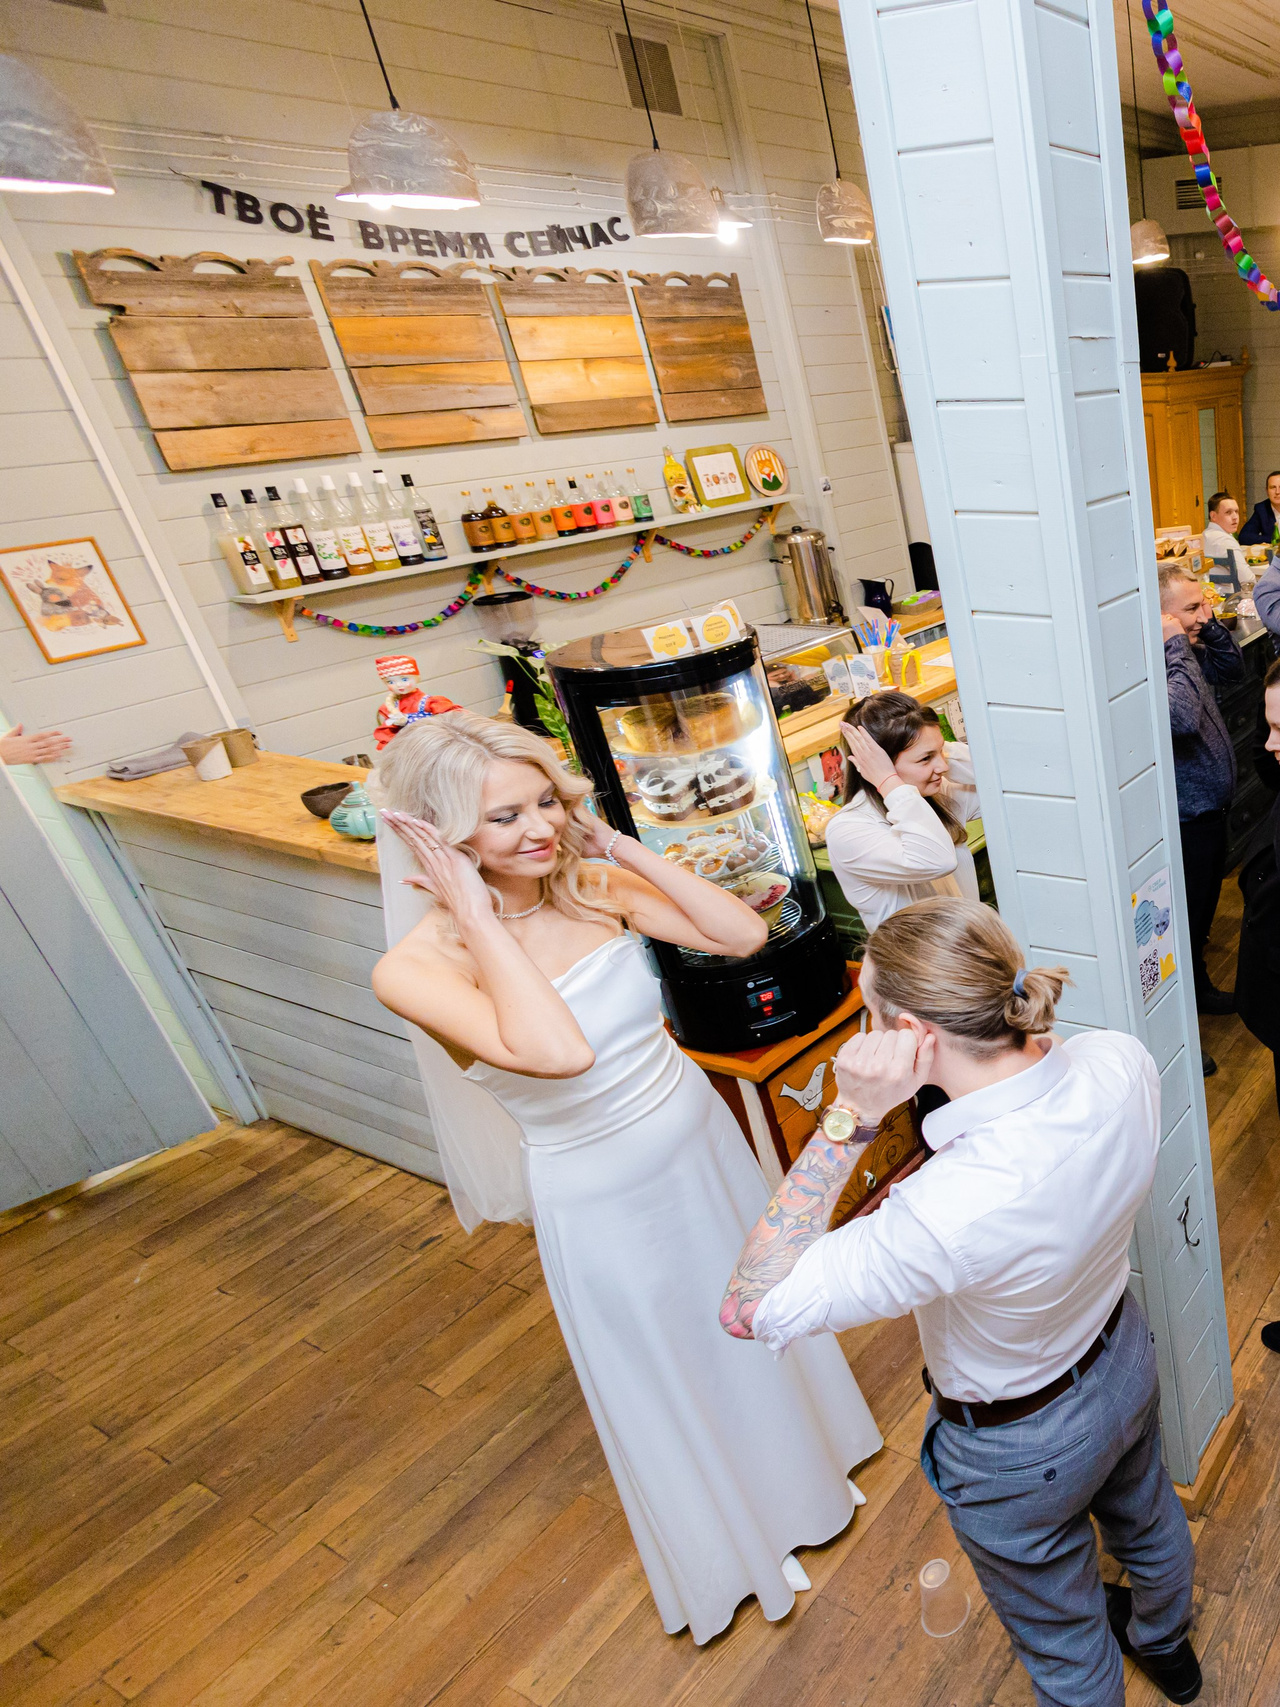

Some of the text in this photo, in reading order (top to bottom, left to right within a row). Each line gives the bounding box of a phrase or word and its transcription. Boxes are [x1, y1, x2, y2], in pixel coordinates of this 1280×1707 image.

[201, 180, 631, 260] ТВОЁ ВРЕМЯ СЕЙЧАС
